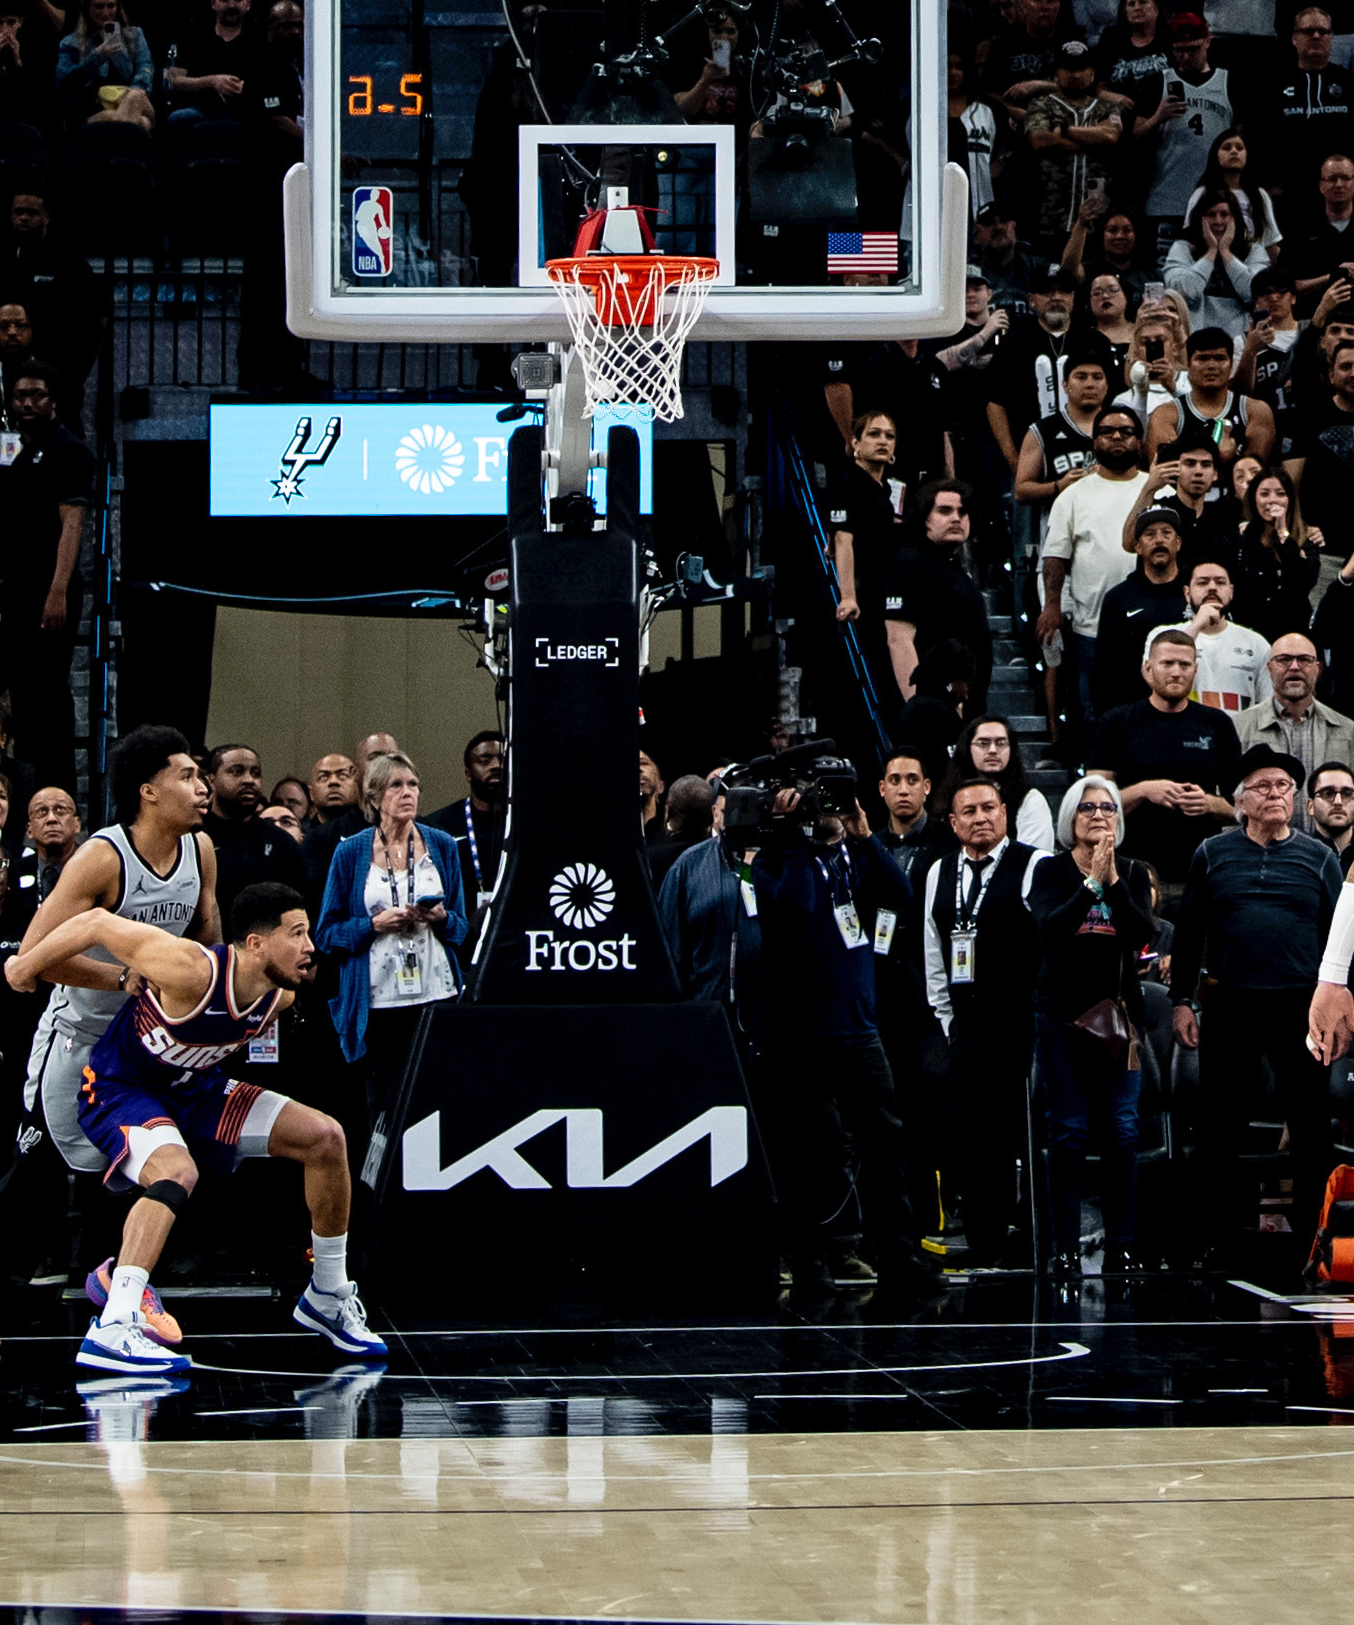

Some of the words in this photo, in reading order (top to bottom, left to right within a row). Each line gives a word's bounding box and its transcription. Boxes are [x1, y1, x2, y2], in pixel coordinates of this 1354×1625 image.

[357, 254, 380, 272] NBA
[548, 646, 607, 659] LEDGER
[524, 930, 637, 972] Frost
[140, 1026, 237, 1071] SUNS
[402, 1105, 749, 1191] KIA
